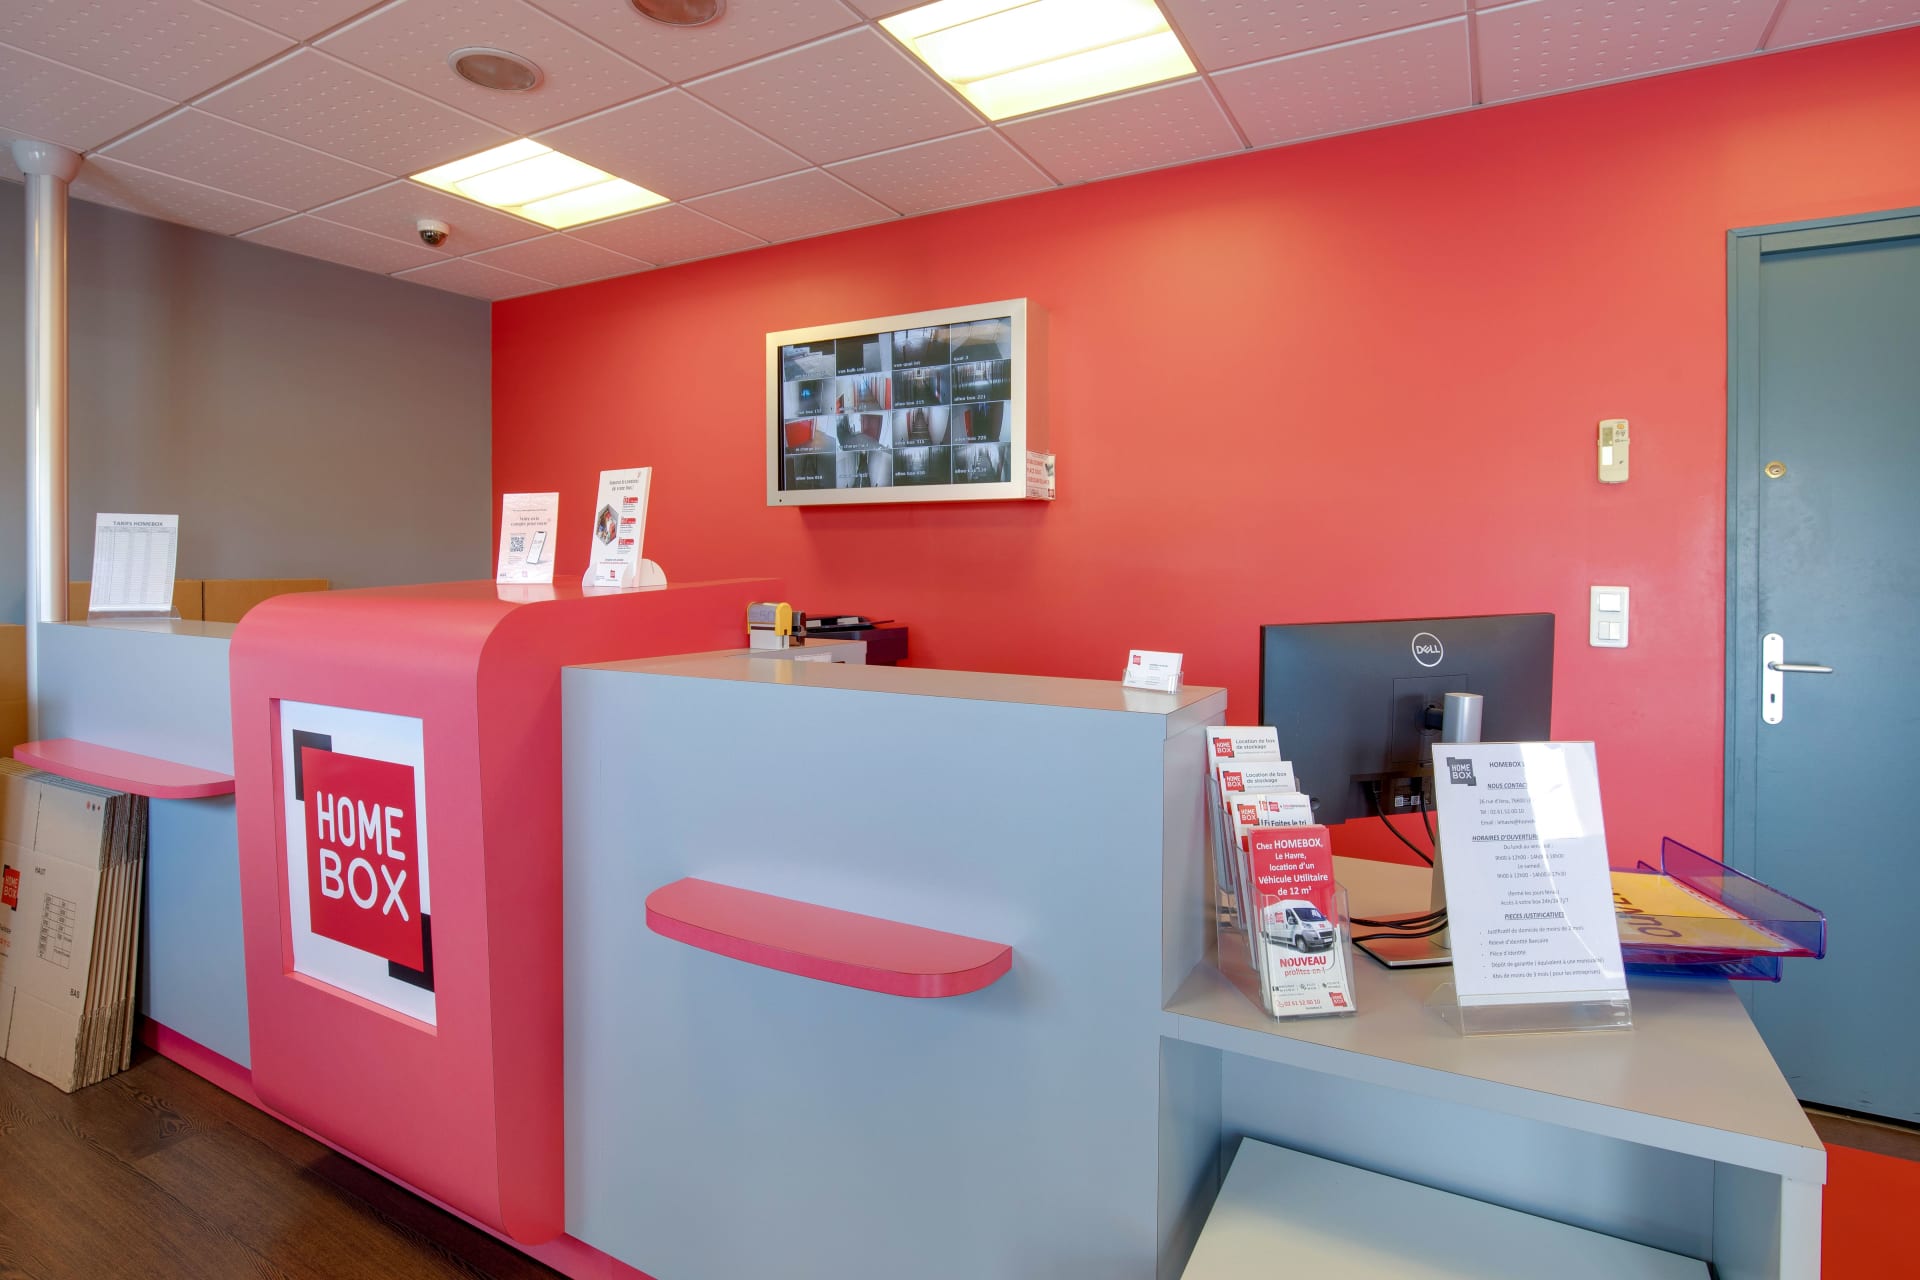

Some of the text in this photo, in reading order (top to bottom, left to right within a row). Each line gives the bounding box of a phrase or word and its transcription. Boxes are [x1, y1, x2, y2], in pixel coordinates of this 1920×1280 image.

[1415, 644, 1441, 655] DELL
[1451, 763, 1471, 772] HOME
[1489, 760, 1521, 768] HOMEBOX
[1452, 771, 1473, 780] BOX
[316, 790, 406, 861] HOME
[1271, 819, 1291, 827] Faites
[1256, 842, 1273, 850] Chez
[1275, 852, 1307, 860] Le Havre,
[1269, 861, 1315, 871] location d'un
[5, 875, 19, 889] HOME
[1258, 872, 1329, 884] Véhicule Utilitaire
[319, 848, 409, 922] BOX
[3, 886, 17, 898] BOX
[1277, 887, 1288, 896] de
[1290, 886, 1300, 895] 12
[1280, 956, 1326, 967] NOUVEAU
[69, 987, 81, 999] BAS
